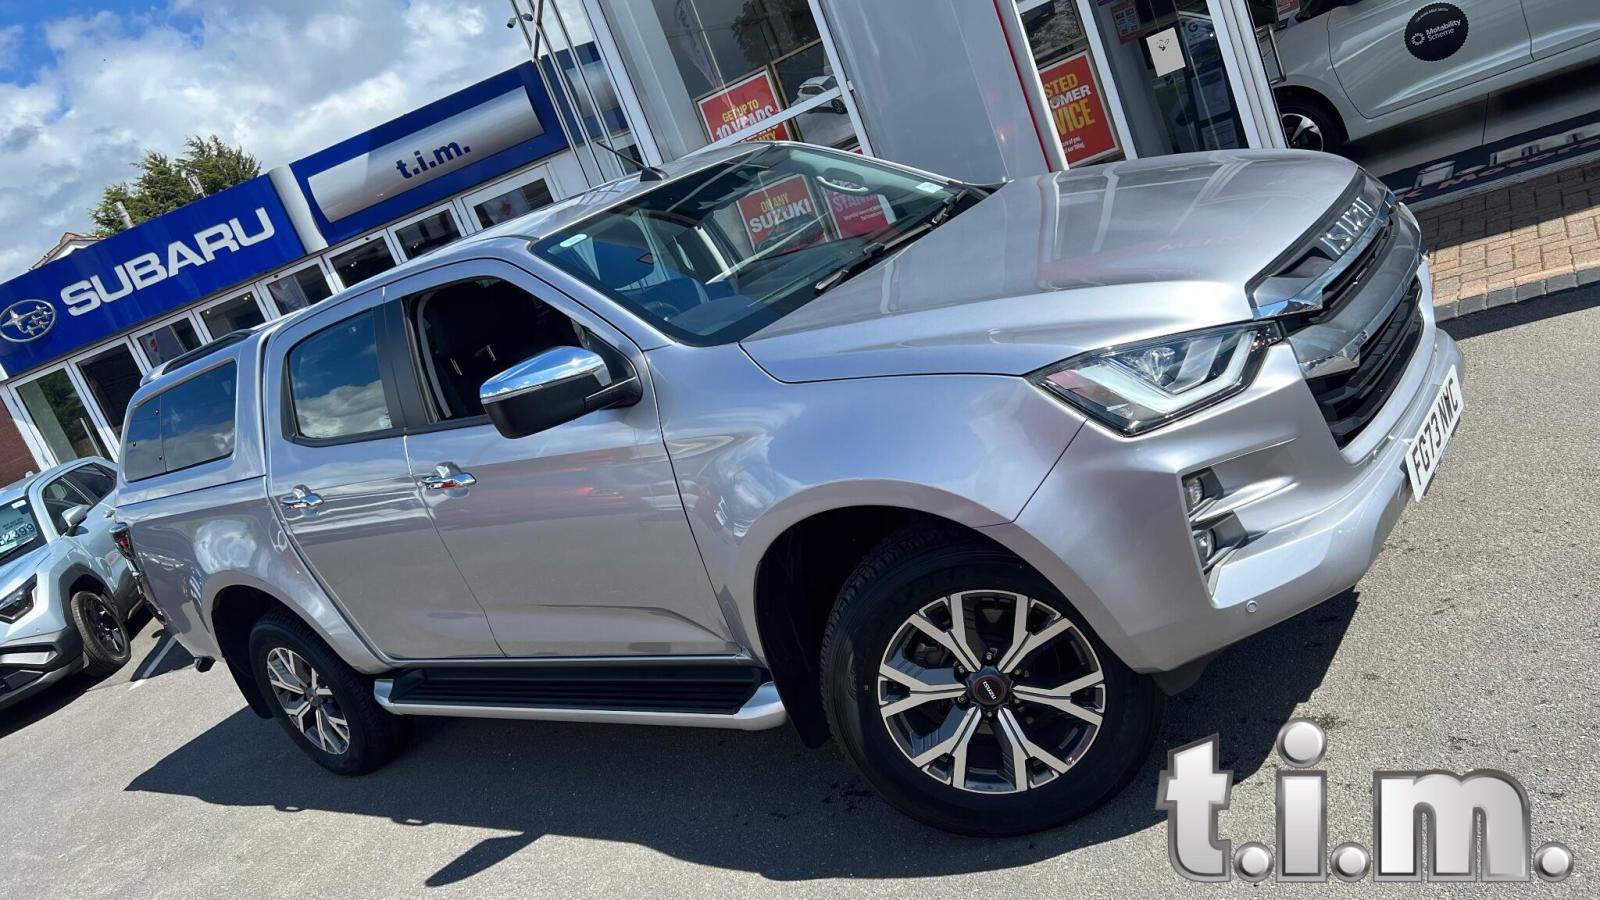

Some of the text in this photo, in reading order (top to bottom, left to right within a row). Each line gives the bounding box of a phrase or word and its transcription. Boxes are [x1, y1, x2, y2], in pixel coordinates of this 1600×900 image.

[1425, 18, 1461, 36] Motability
[1427, 27, 1455, 42] Scheme
[722, 99, 759, 123] GET UP TO
[396, 139, 472, 180] t.i.m.
[749, 199, 812, 233] SUZUKI
[1320, 196, 1375, 257] ISUZU
[60, 207, 276, 317] SUBARU
[1411, 377, 1459, 486] FG73 NWC
[982, 681, 997, 700] ISUZU
